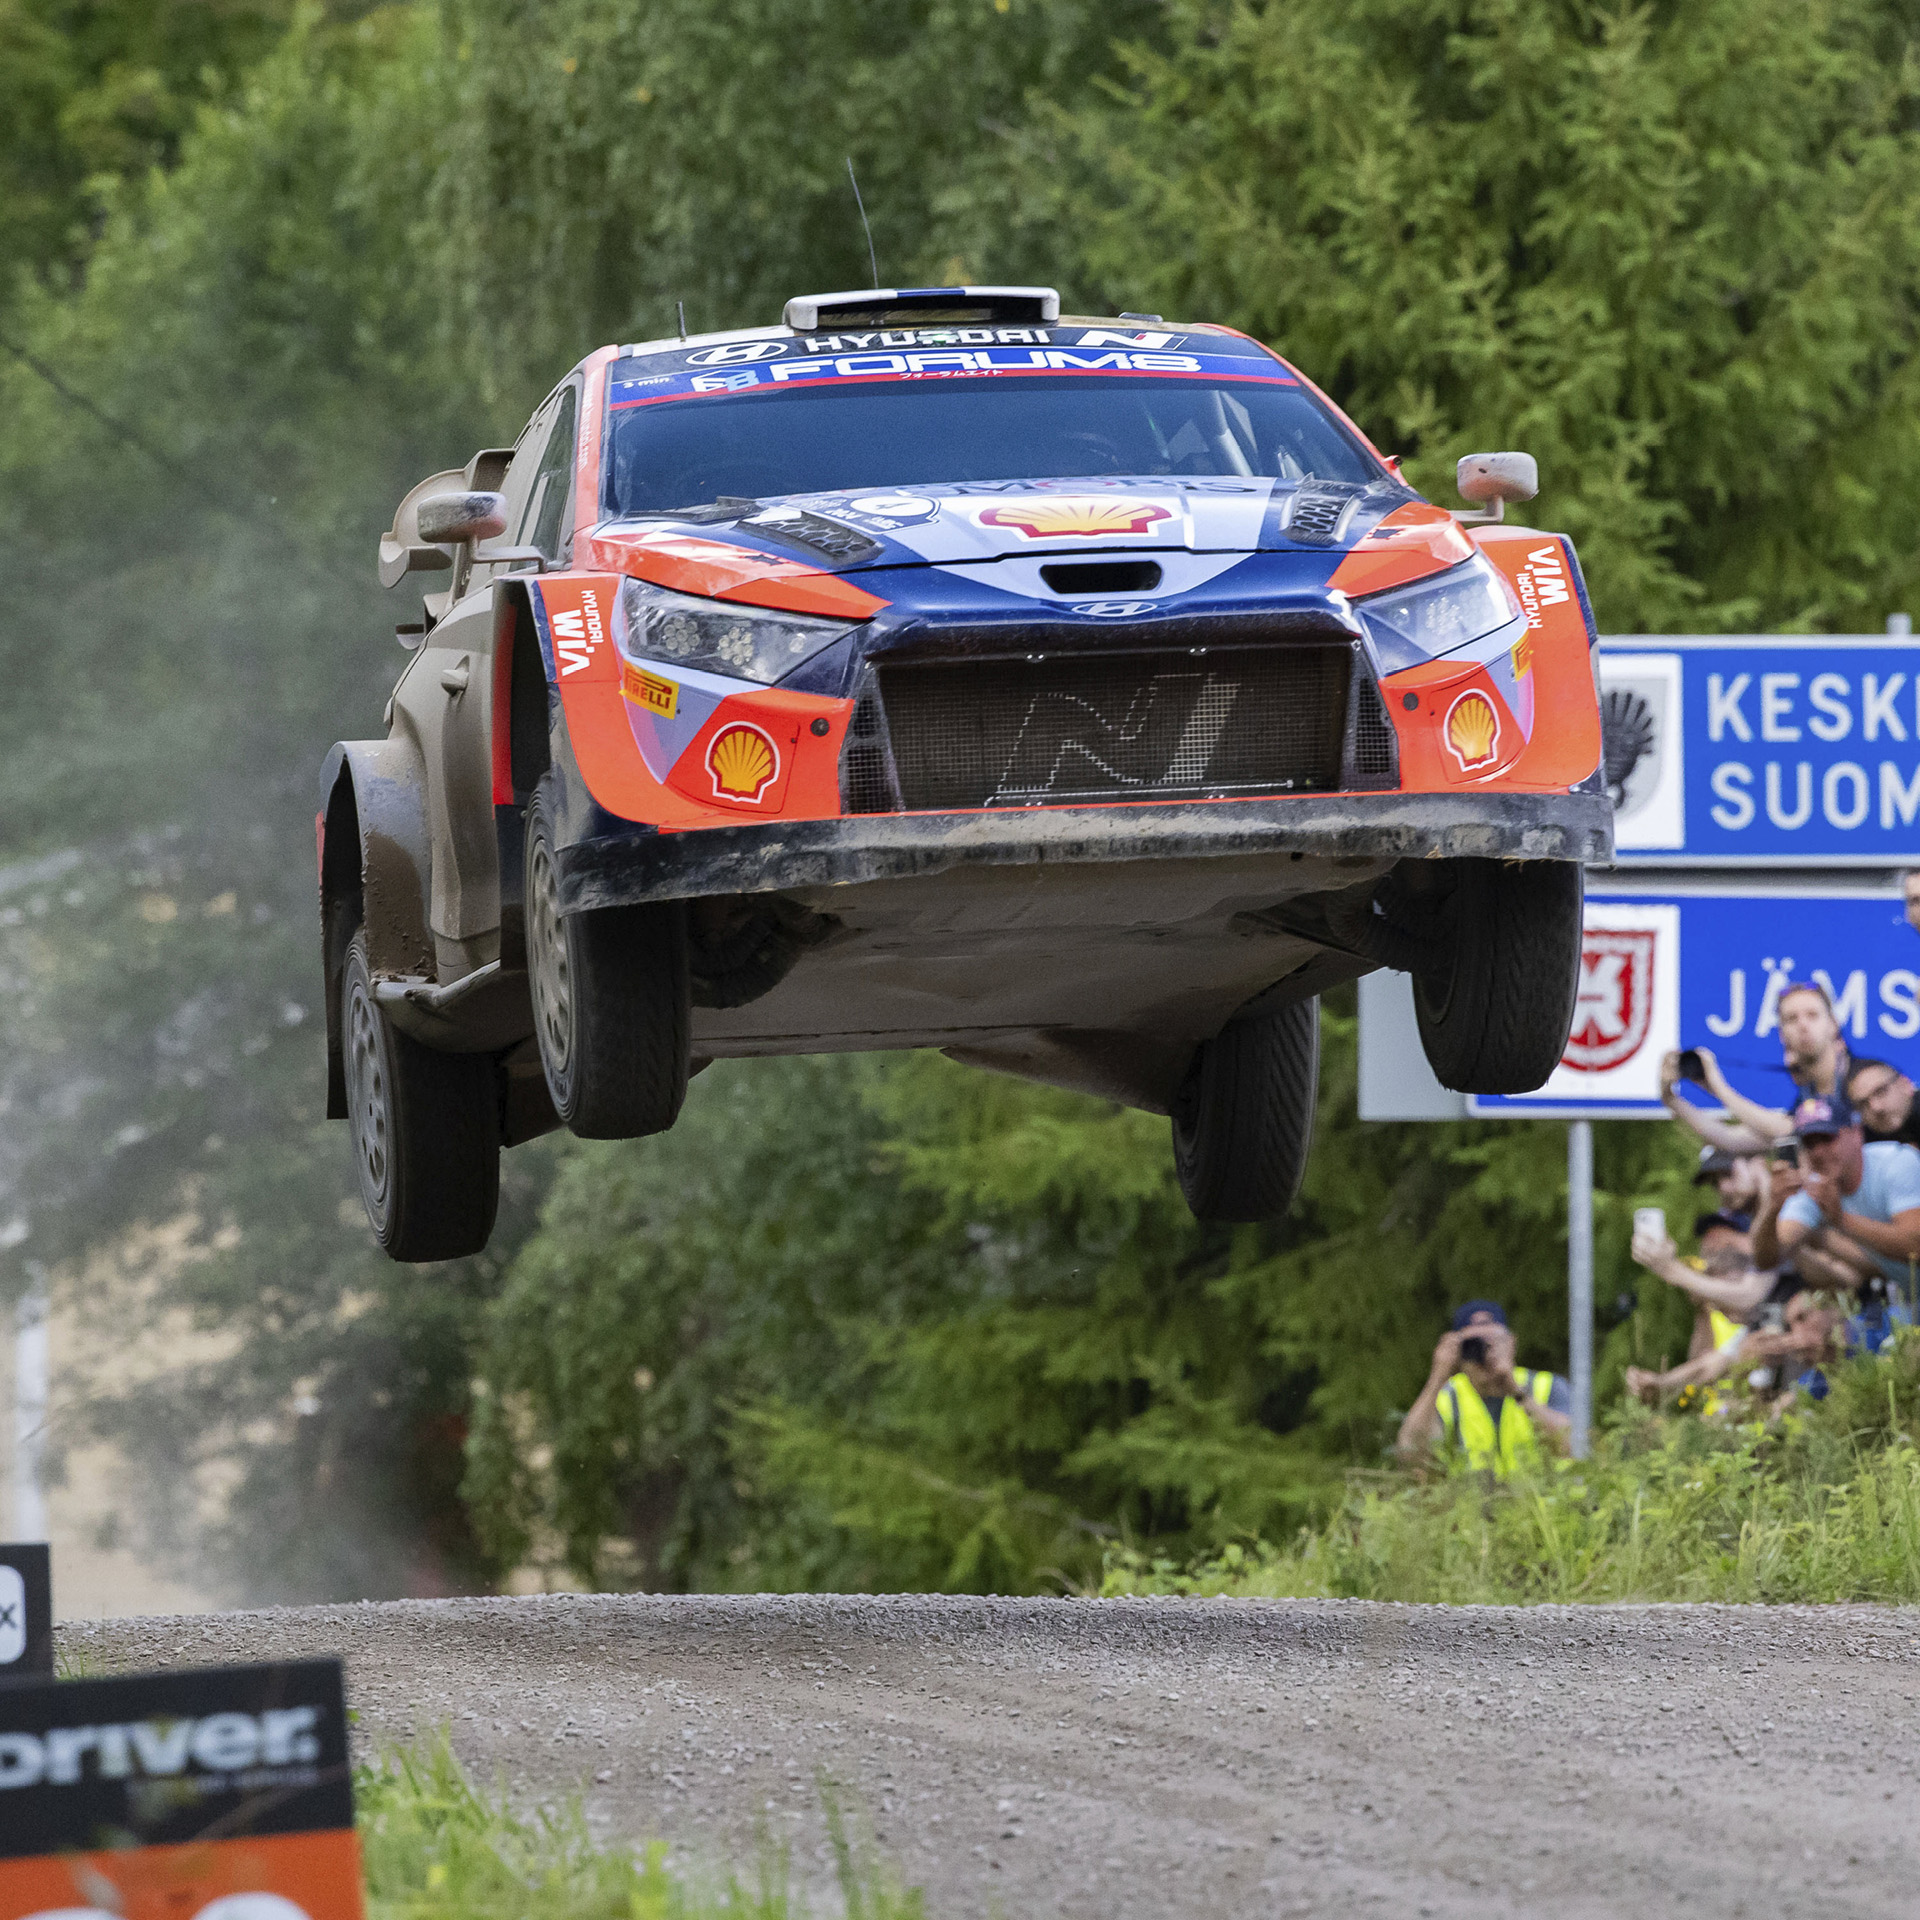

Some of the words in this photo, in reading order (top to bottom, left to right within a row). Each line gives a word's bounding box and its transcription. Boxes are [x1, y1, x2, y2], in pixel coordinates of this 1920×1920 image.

[637, 377, 670, 387] min
[769, 351, 1202, 381] FORUM8
[581, 589, 604, 643] HYUNDAI
[1516, 572, 1543, 629] HYUNDAI
[1710, 761, 1920, 830] SUOM
